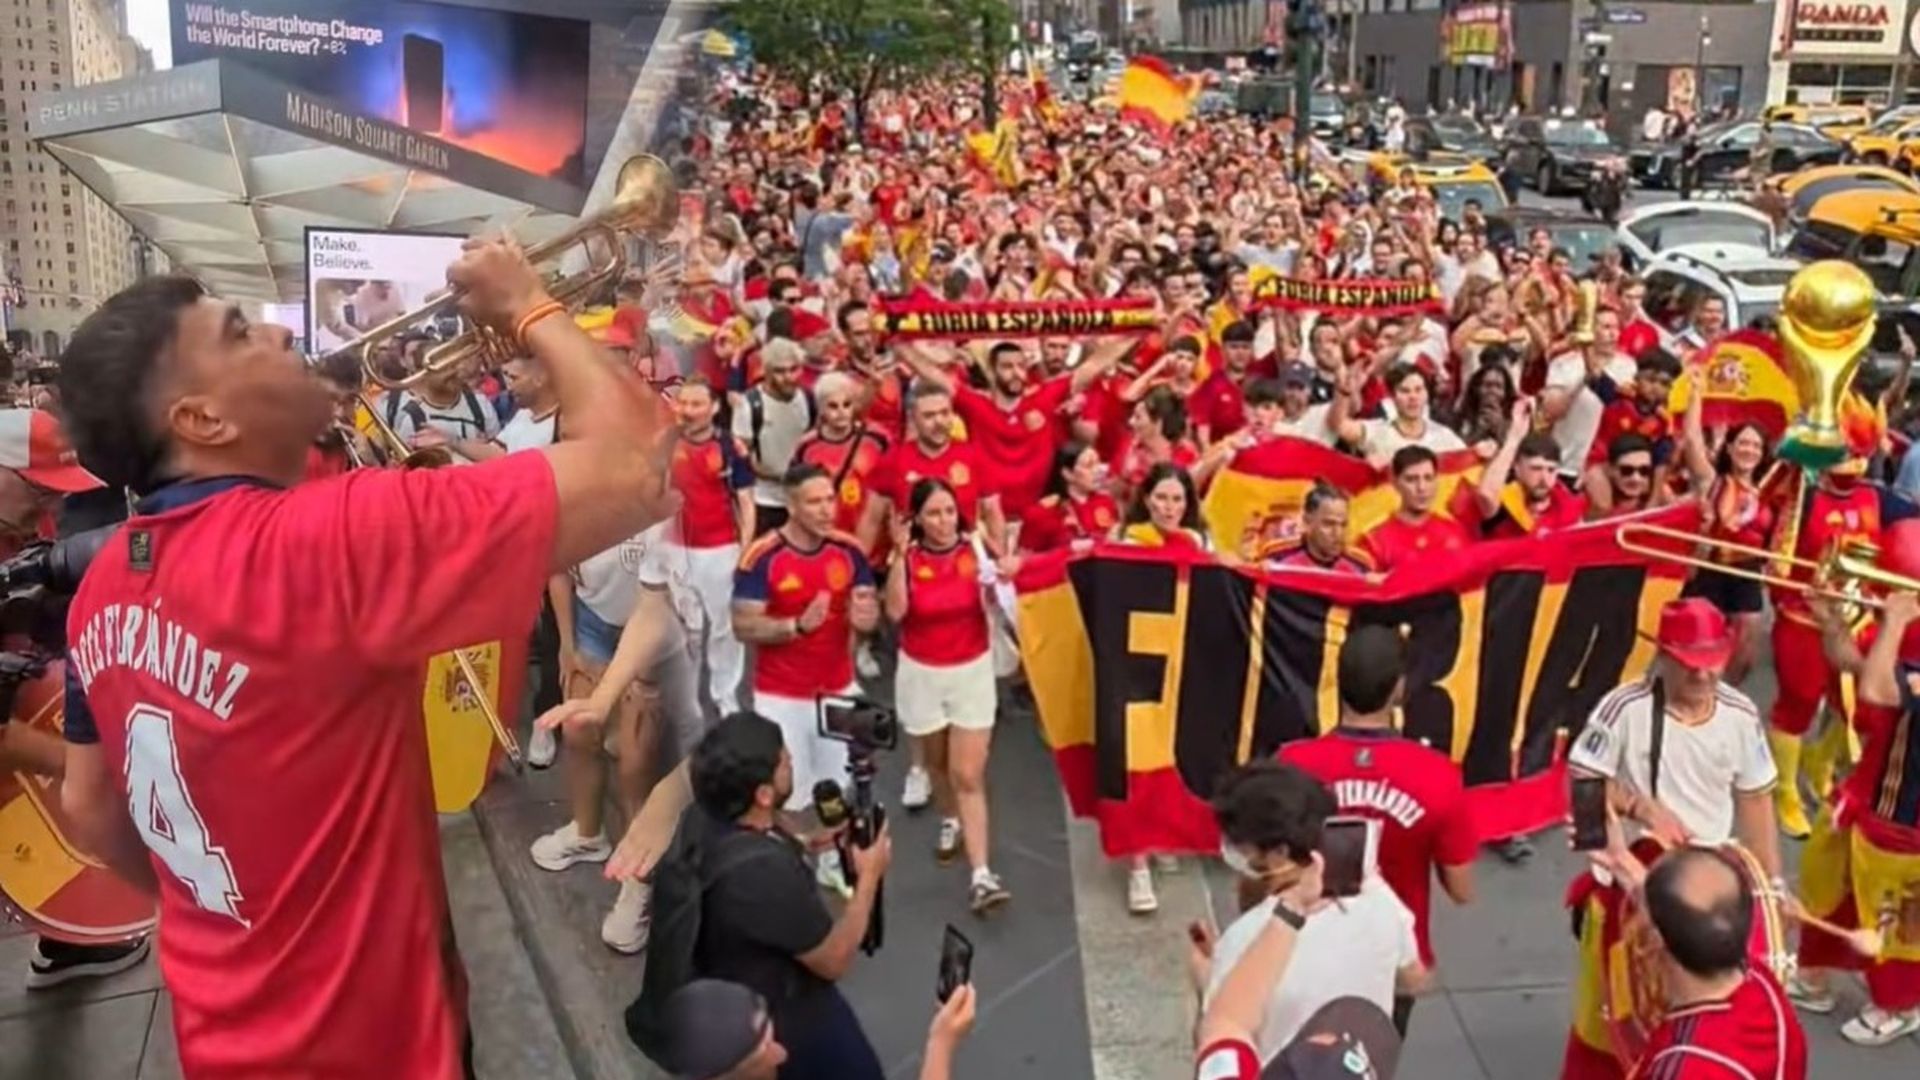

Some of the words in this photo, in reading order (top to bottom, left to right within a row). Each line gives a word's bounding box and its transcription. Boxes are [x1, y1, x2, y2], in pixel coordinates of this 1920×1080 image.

[186, 4, 213, 23] Will
[214, 9, 238, 26] the
[241, 10, 328, 37] Smartphone
[330, 20, 383, 45] Change
[1799, 4, 1890, 25] PANDA
[187, 26, 211, 43] the
[213, 28, 256, 49] World
[258, 34, 320, 55] Forever?
[122, 702, 252, 930] 4
